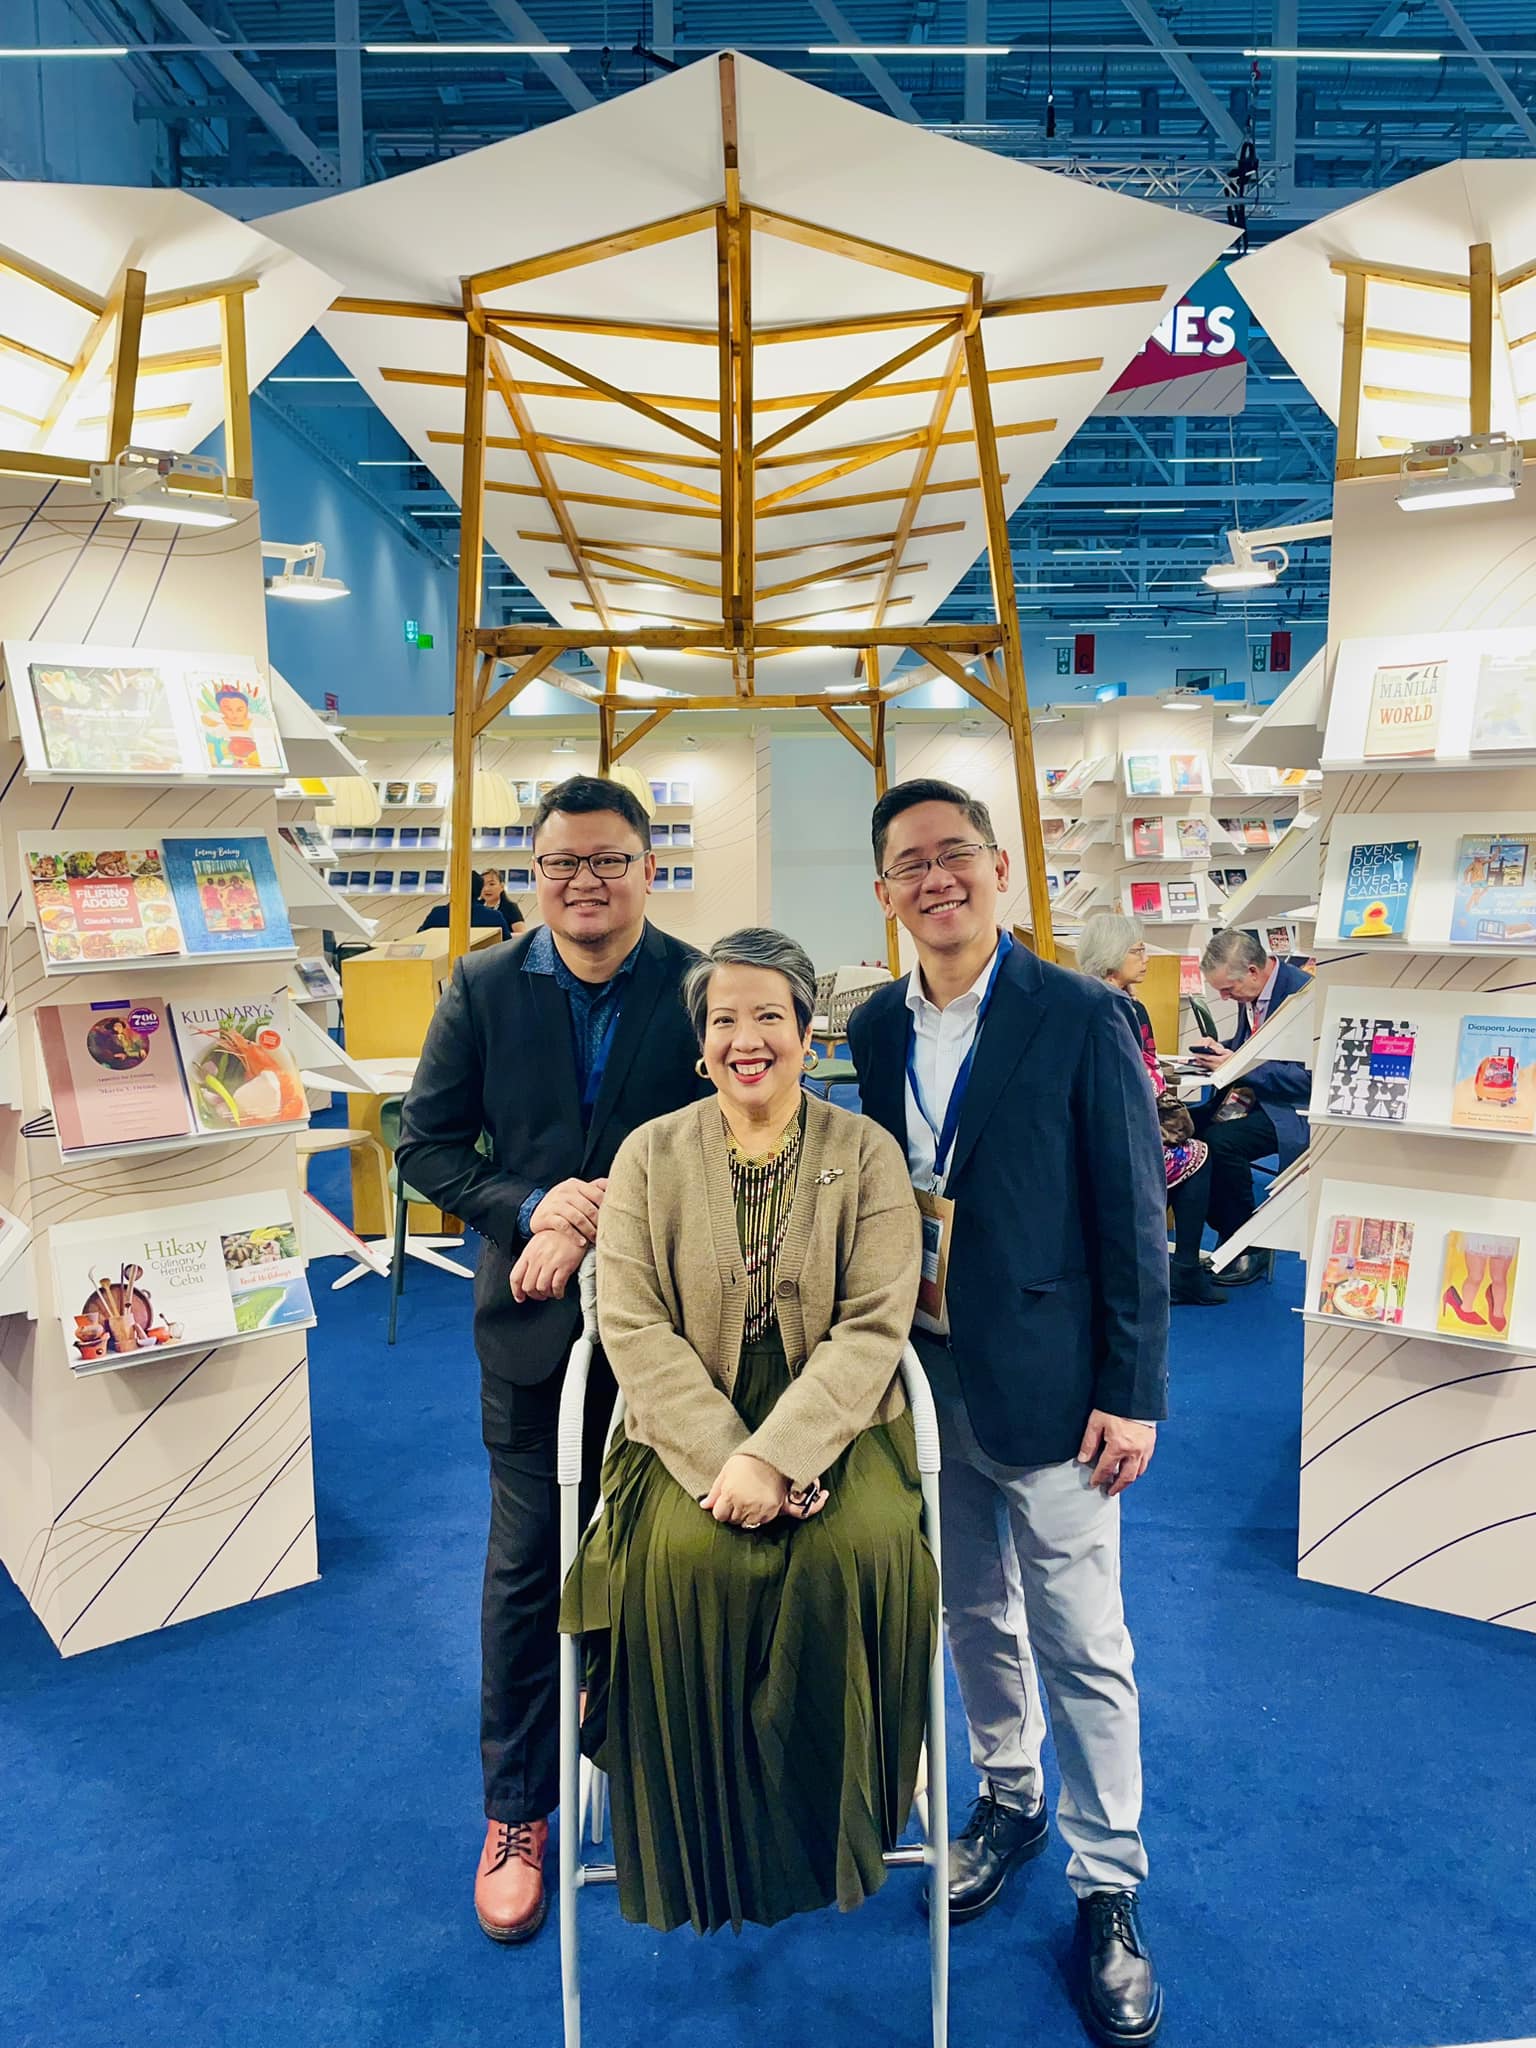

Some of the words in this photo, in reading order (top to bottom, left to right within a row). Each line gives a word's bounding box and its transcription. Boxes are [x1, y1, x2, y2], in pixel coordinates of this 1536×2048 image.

[1379, 679, 1438, 698] MANILA
[1380, 704, 1433, 725] WORLD
[1353, 844, 1394, 857] EVEN
[1352, 853, 1403, 867] DUCKS
[1351, 865, 1379, 877] GET
[1349, 874, 1391, 887] LIVER
[75, 887, 130, 900] FILIPINO
[1347, 882, 1409, 897] CANCER
[82, 897, 129, 910] ADOBO
[131, 1014, 157, 1026] 700
[1467, 1023, 1505, 1033] Diaspora
[144, 1237, 208, 1260] Hikay
[151, 1257, 196, 1272] Culinary
[160, 1261, 207, 1278] Heritage
[169, 1274, 205, 1288] Cebu
